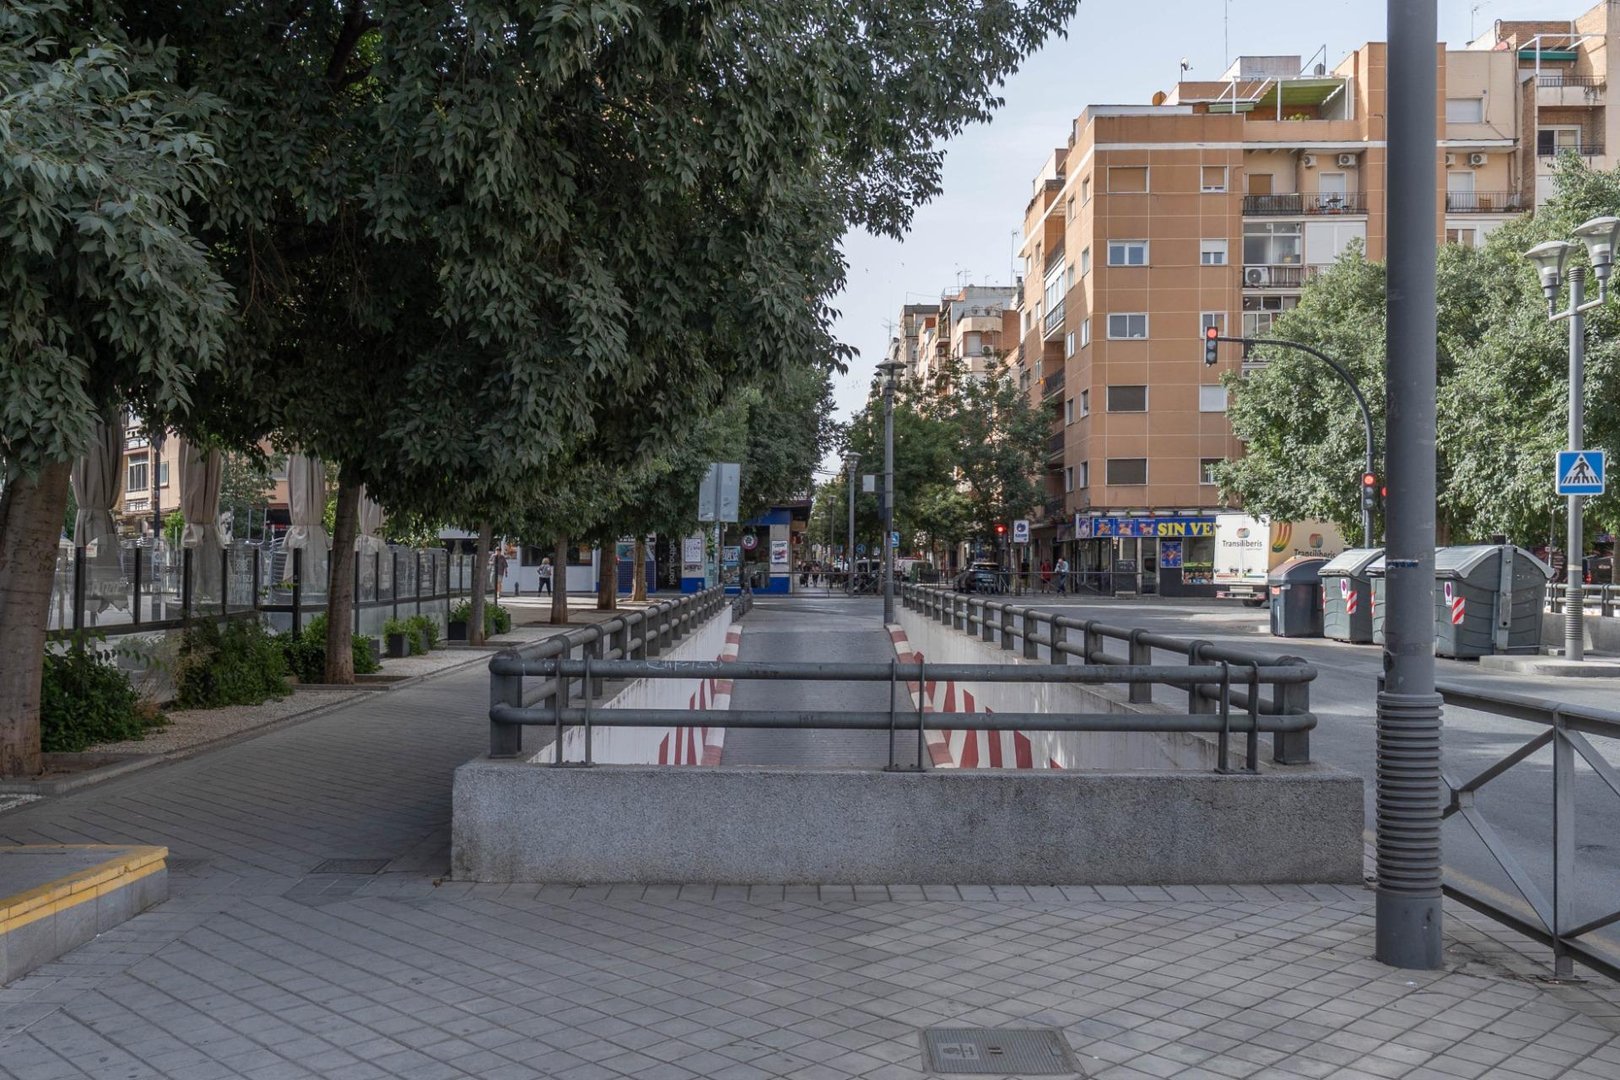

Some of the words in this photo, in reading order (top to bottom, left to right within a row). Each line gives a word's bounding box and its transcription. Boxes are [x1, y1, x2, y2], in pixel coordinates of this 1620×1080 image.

[1157, 522, 1187, 536] SIN
[1190, 522, 1216, 536] VE
[1222, 539, 1263, 547] Transiliberis
